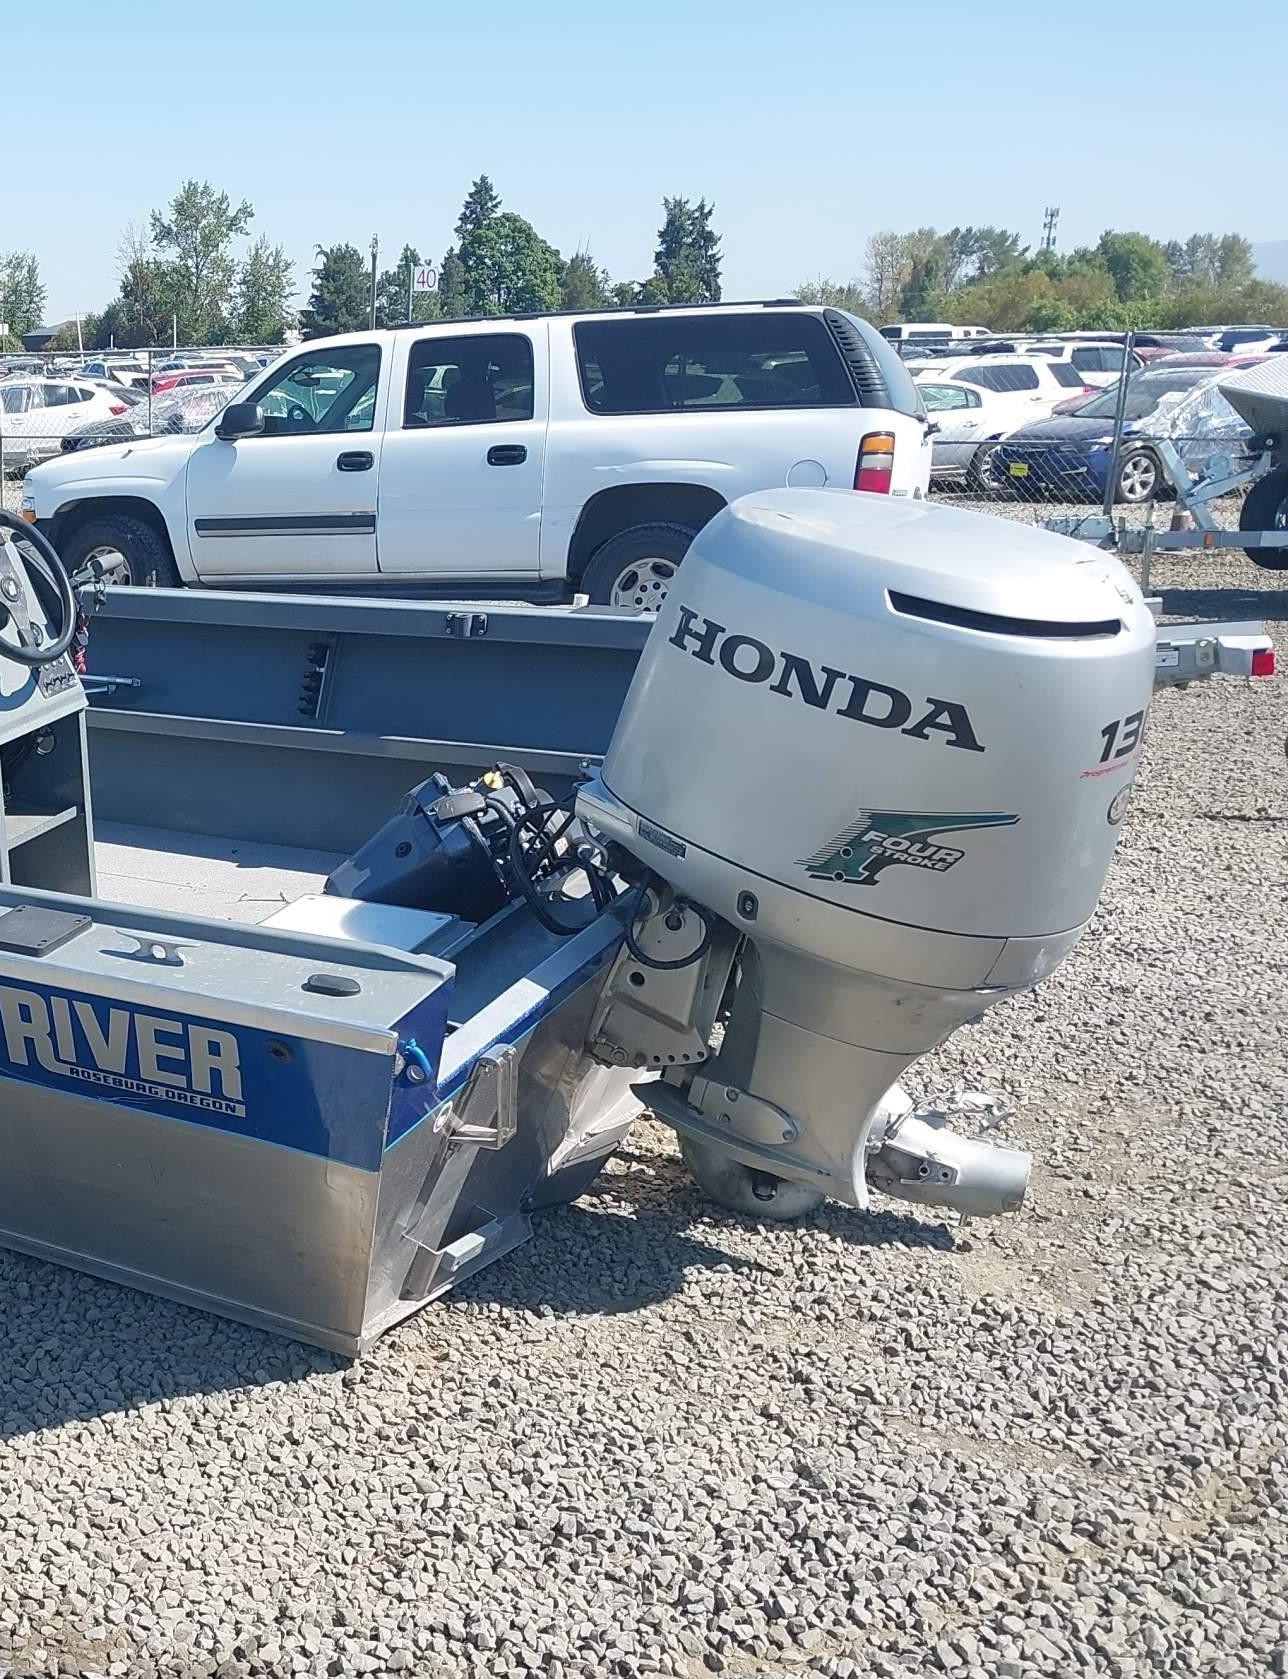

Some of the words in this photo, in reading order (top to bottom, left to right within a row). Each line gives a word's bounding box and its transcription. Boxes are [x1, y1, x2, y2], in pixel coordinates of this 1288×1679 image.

[415, 268, 437, 289] 40
[668, 604, 986, 753] HONDA
[861, 830, 963, 863] FOUR
[869, 845, 950, 870] STROKE
